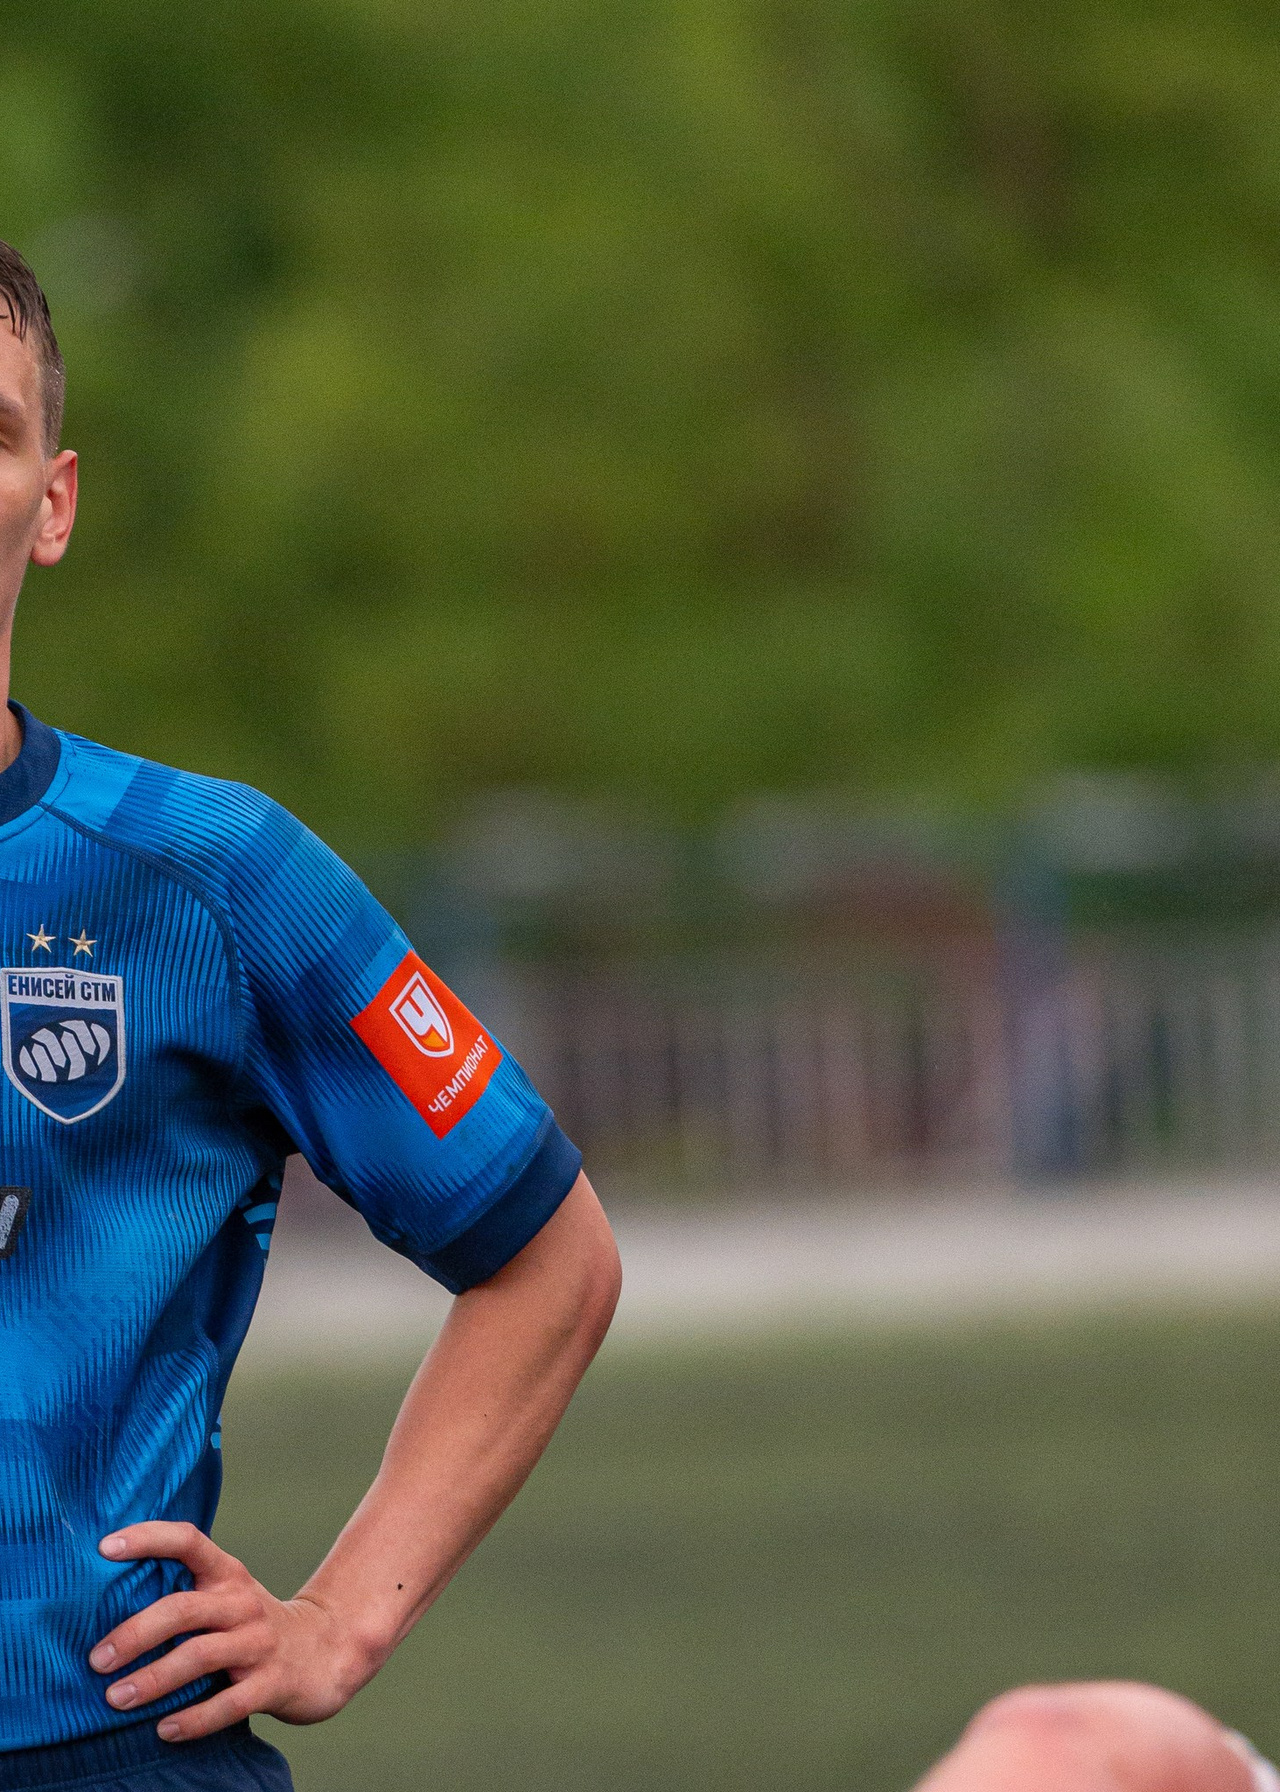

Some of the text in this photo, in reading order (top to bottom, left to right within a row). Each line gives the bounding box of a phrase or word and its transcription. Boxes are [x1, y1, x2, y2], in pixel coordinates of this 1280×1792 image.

[8, 974, 116, 1003] ЕНИСЕЙ СТМ
[427, 1034, 489, 1113] ЧЕМПИОНАТ
